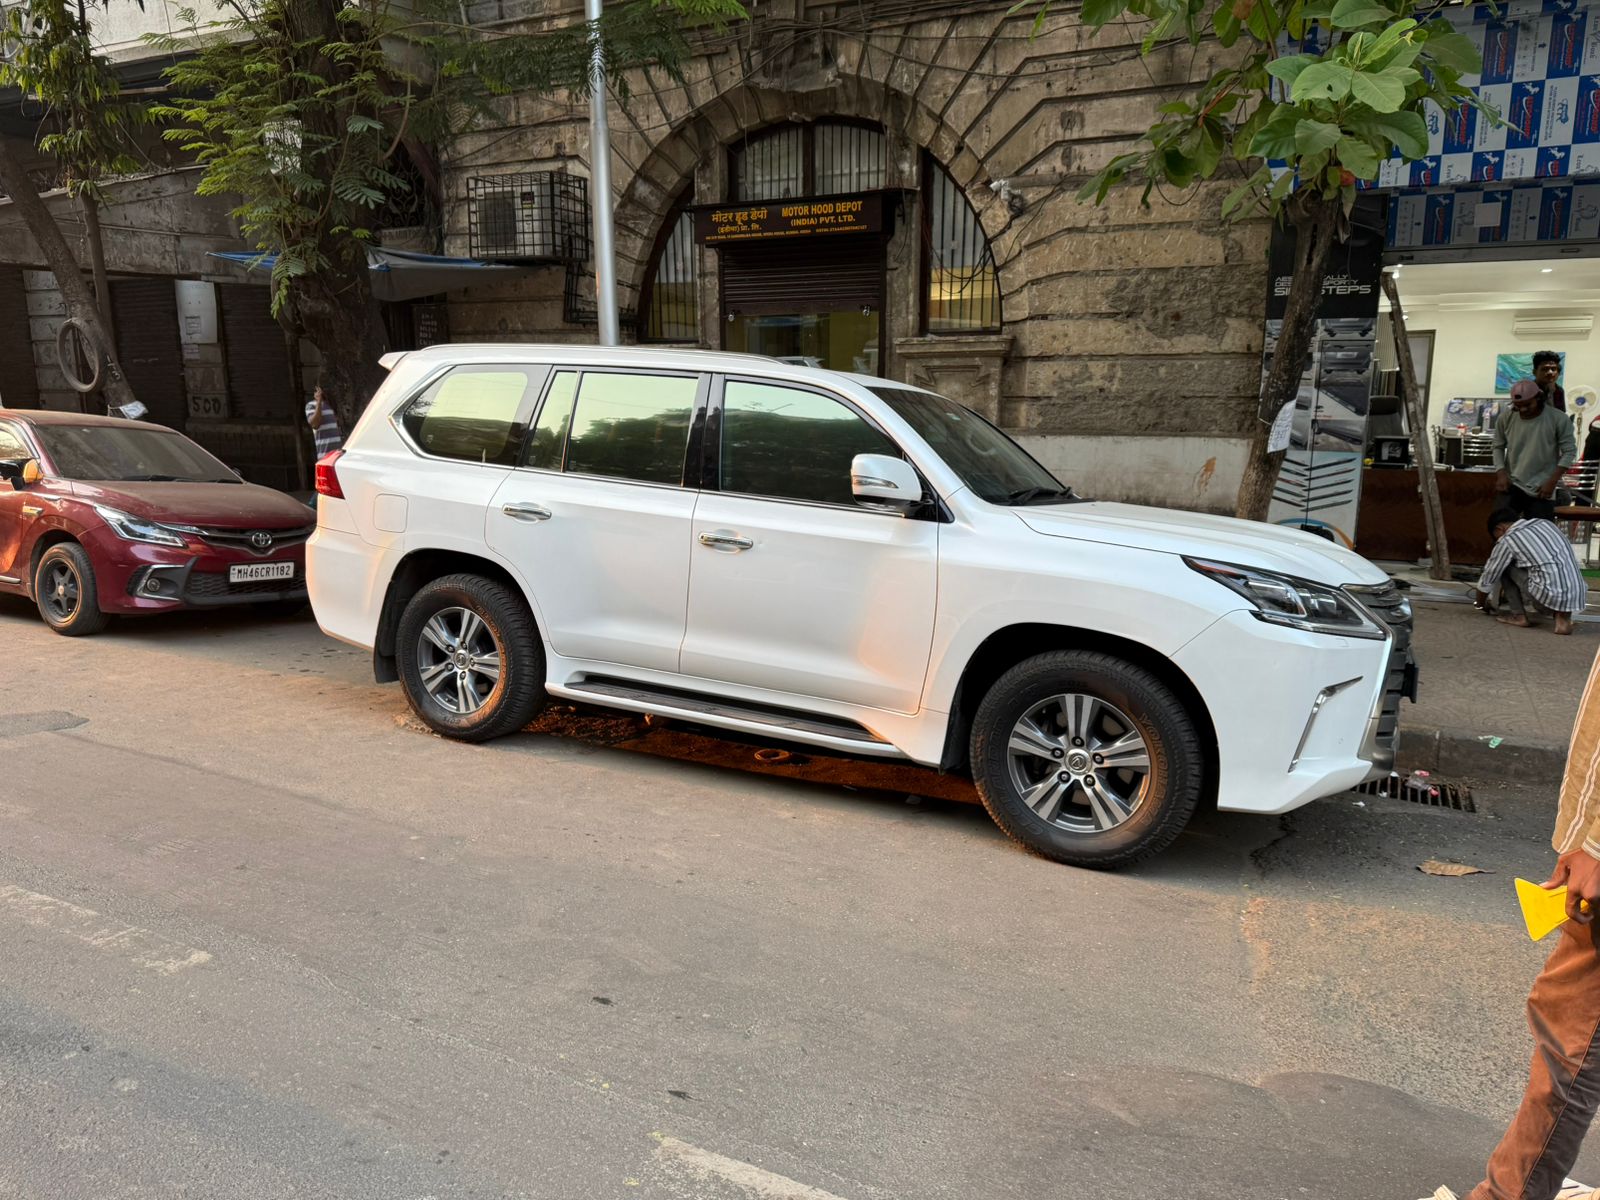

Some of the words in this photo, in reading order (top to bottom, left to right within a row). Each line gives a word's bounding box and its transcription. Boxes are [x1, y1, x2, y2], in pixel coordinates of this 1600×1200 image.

[712, 210, 733, 222] मोटर
[782, 205, 809, 217] MOTOR
[811, 203, 834, 215] HOOD
[836, 201, 863, 213] DEPOT
[790, 217, 818, 227] (INDIA)
[819, 215, 836, 224] PVT.
[838, 214, 856, 223] LTD.
[192, 396, 221, 415] 500
[236, 565, 291, 579] MH46CR1182
